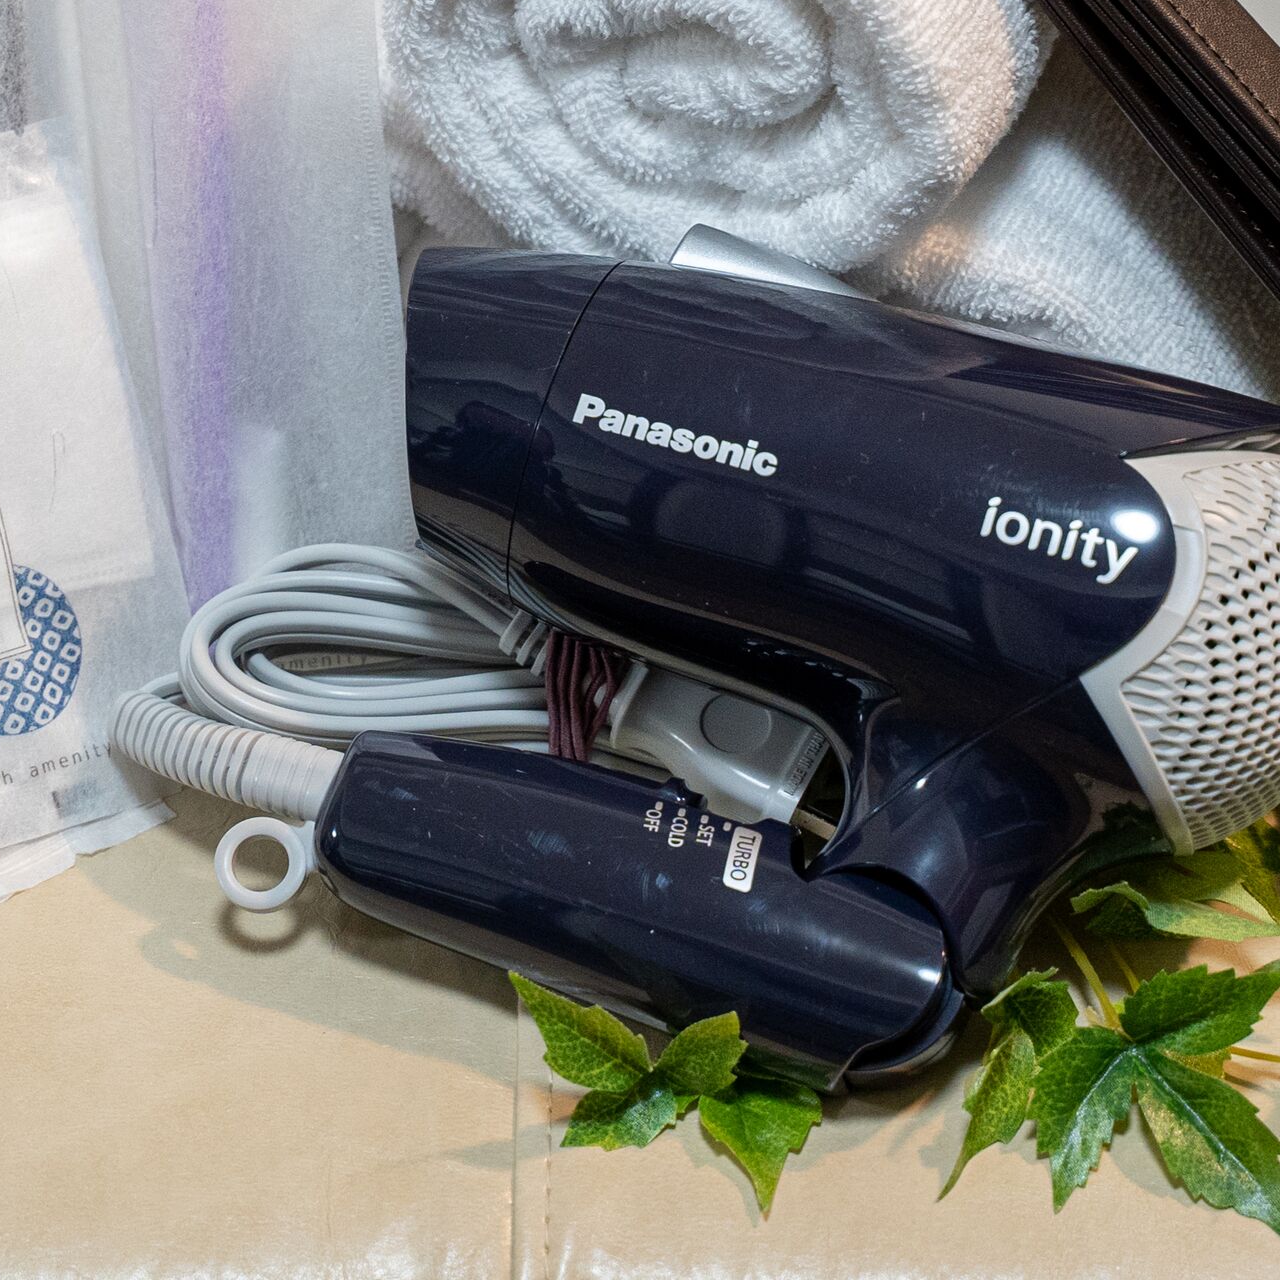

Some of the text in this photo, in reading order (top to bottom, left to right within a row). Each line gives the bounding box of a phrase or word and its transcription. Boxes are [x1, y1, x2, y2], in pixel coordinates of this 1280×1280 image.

[572, 392, 779, 477] Panasonic
[979, 495, 1140, 585] ionity
[29, 741, 113, 779] amenity
[643, 808, 663, 833] OFF
[666, 816, 689, 849] COLD
[695, 823, 716, 848] SET
[730, 835, 756, 881] TURBO
